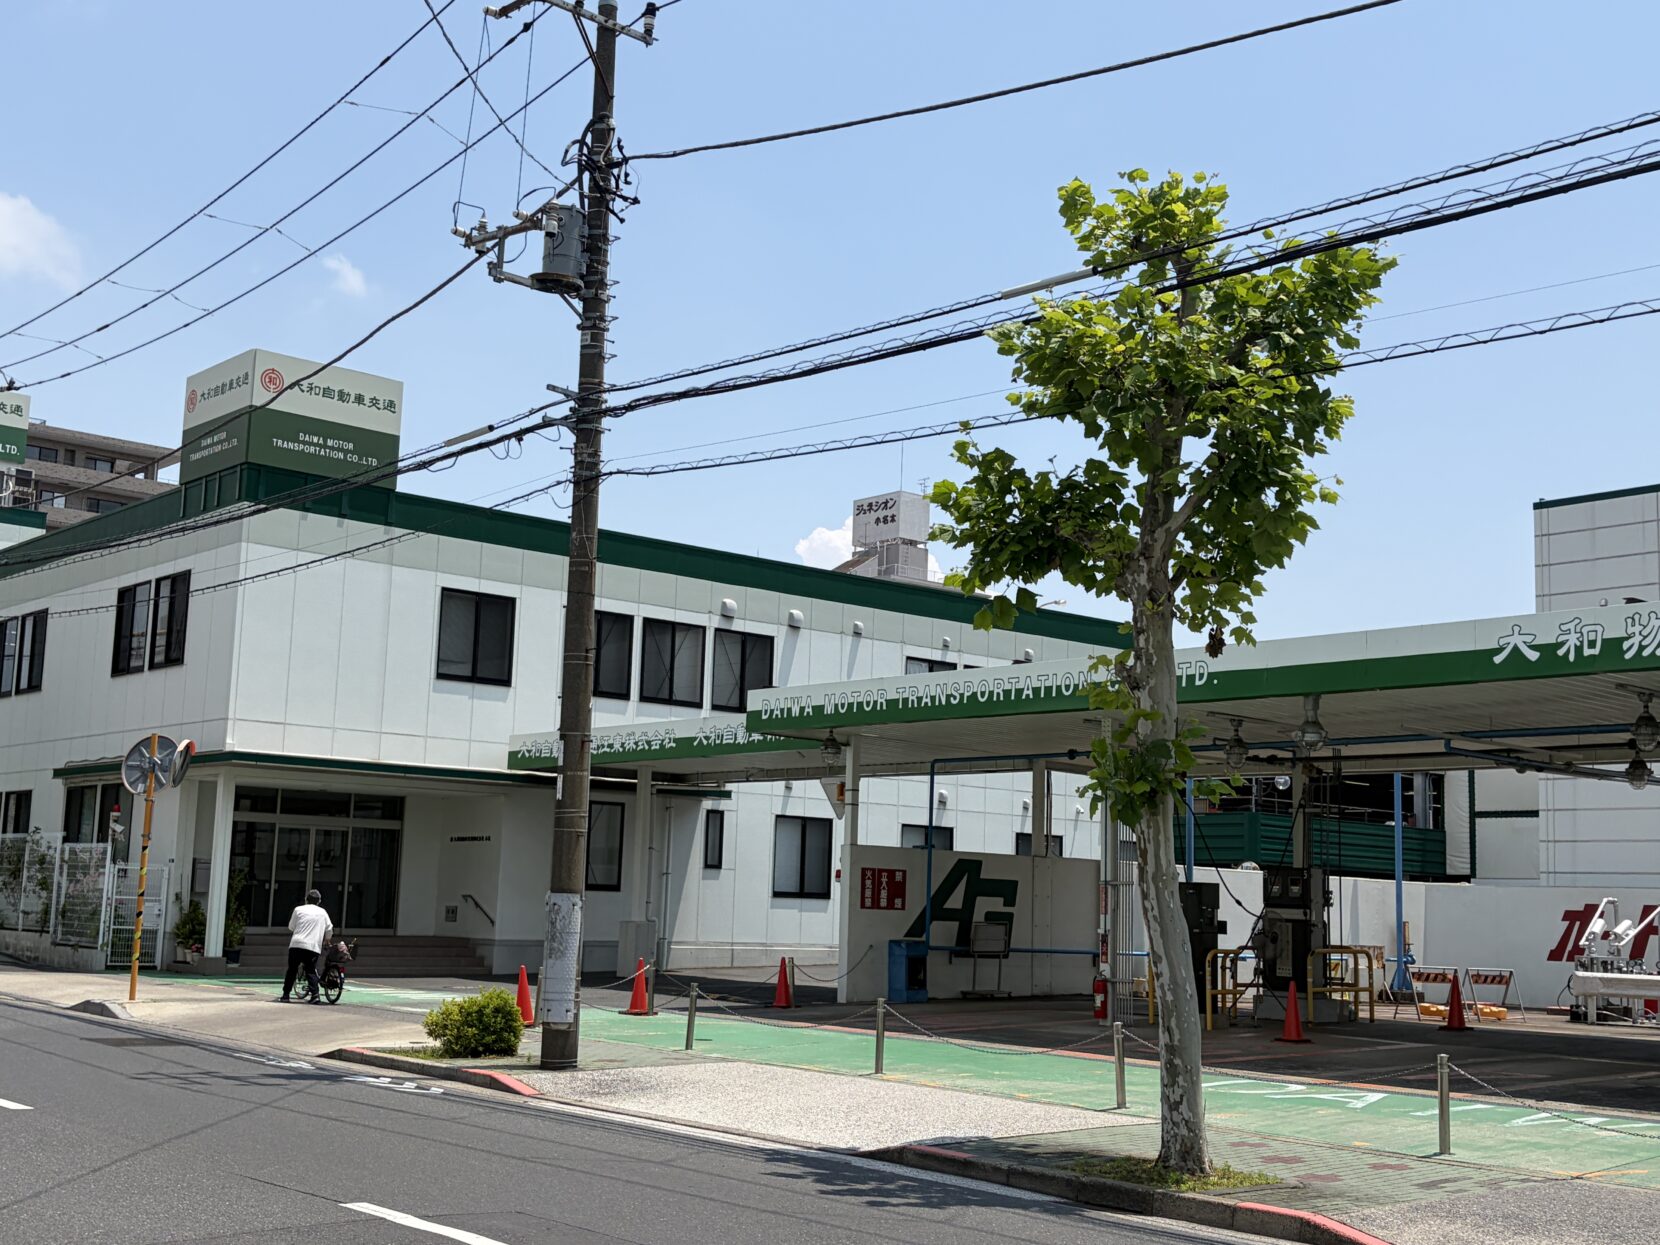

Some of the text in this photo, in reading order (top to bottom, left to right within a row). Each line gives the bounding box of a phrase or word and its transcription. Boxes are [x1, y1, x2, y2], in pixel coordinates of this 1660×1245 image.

[199, 371, 249, 403] 大和自動車交通
[272, 438, 344, 460] TRANSPORTATION
[299, 432, 354, 451] DAIWA MOTOR
[761, 695, 813, 720] DAIWA
[823, 688, 888, 715] MOTOR
[896, 671, 1092, 709] TRANSPORTATION
